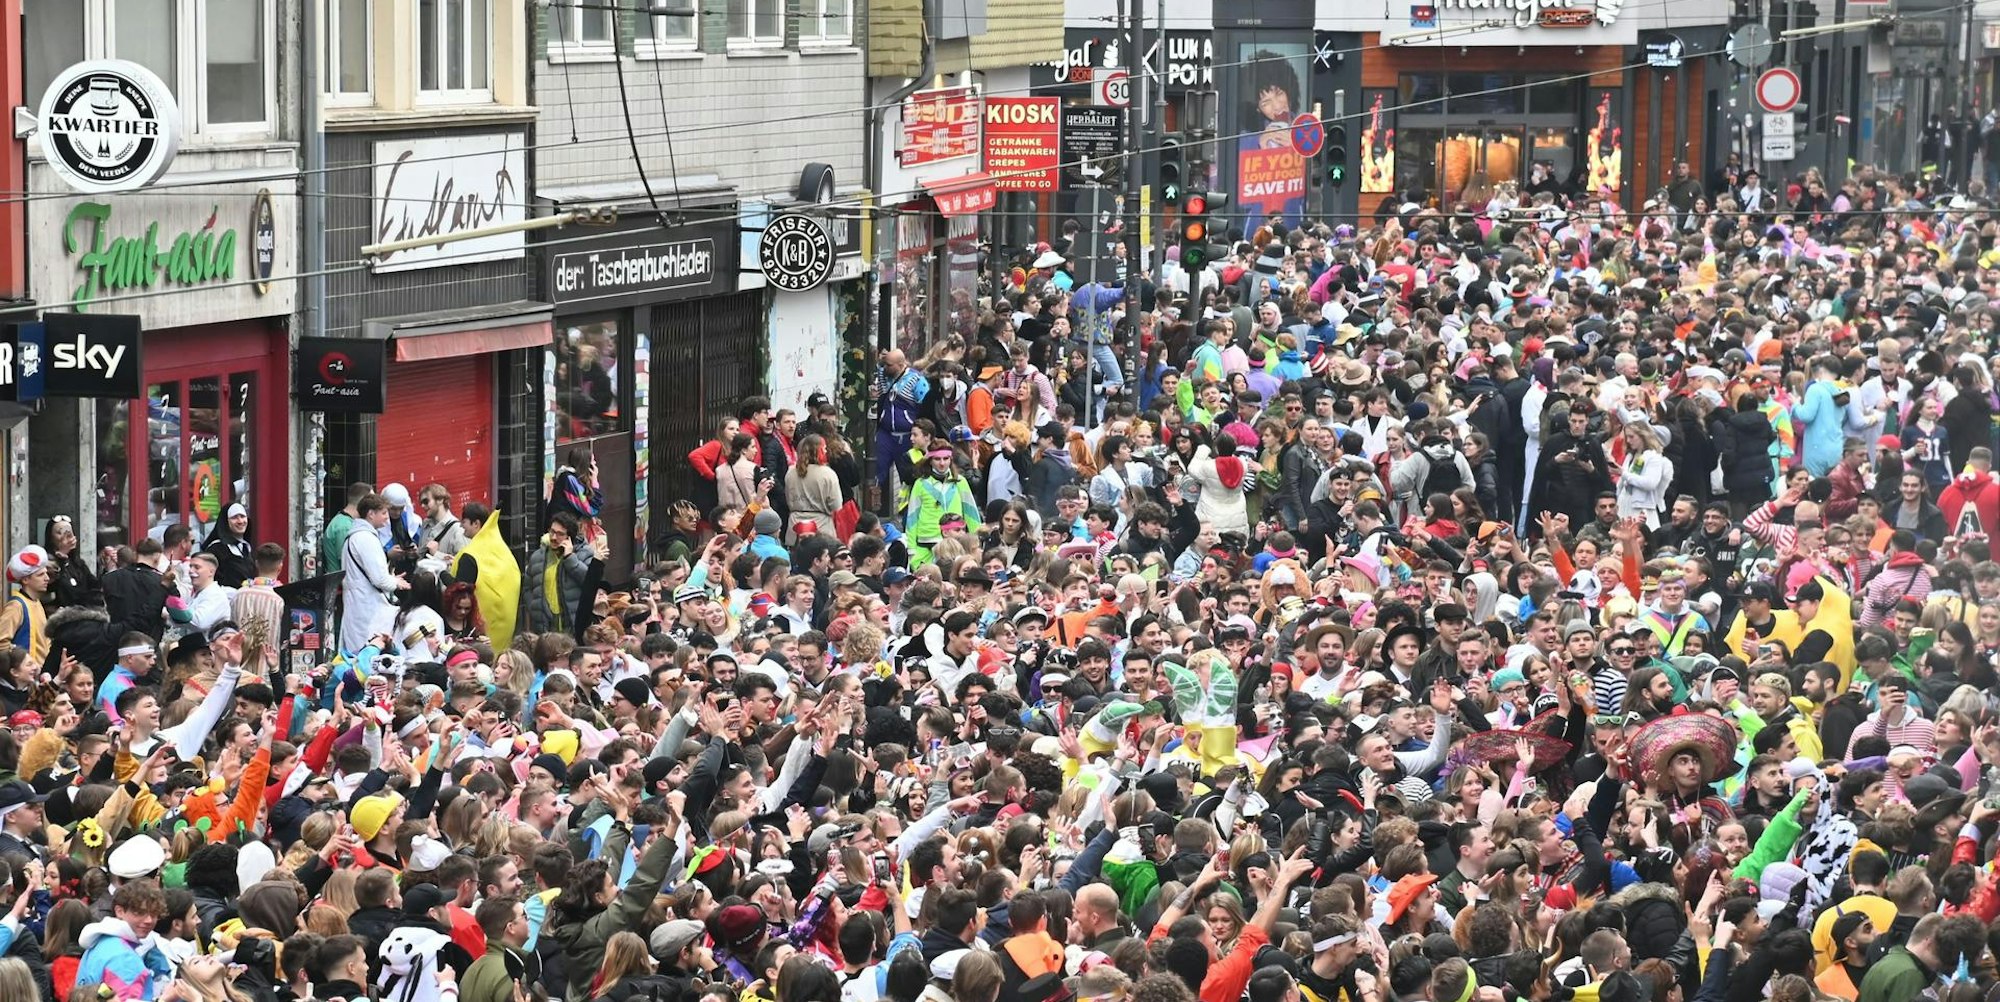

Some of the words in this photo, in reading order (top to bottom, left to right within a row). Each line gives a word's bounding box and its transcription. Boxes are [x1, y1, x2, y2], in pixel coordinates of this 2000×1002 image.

[64, 84, 84, 104] DEINE
[126, 86, 148, 111] KNEIPE
[1109, 81, 1130, 100] 30
[986, 104, 1056, 124] KIOSK
[1066, 115, 1118, 127] HERBALIST
[48, 116, 159, 136] KWARTIER
[988, 138, 1042, 147] GETRÄNKE
[988, 147, 1056, 156] TABAKWAREN
[78, 162, 98, 176] DEIN
[100, 165, 131, 178] VEEDEL
[1244, 156, 1263, 173] IF
[1266, 153, 1304, 171] YOU
[995, 180, 1022, 188] OFFEE
[1038, 180, 1052, 188] GO
[1244, 171, 1273, 184] LOVE
[1275, 168, 1302, 180] FOOD
[1242, 180, 1285, 198] SAVE
[1287, 178, 1303, 193] IT!
[763, 218, 827, 247] FRISEUR
[64, 202, 237, 314] Fant-asia
[781, 238, 808, 267] K&B
[556, 257, 585, 292] der:
[588, 242, 711, 287] Taschenbuchladen
[763, 259, 826, 289] 9383320
[53, 333, 126, 379] sky
[311, 383, 360, 396] Fant-asia
[1716, 550, 1735, 561] SWAT
